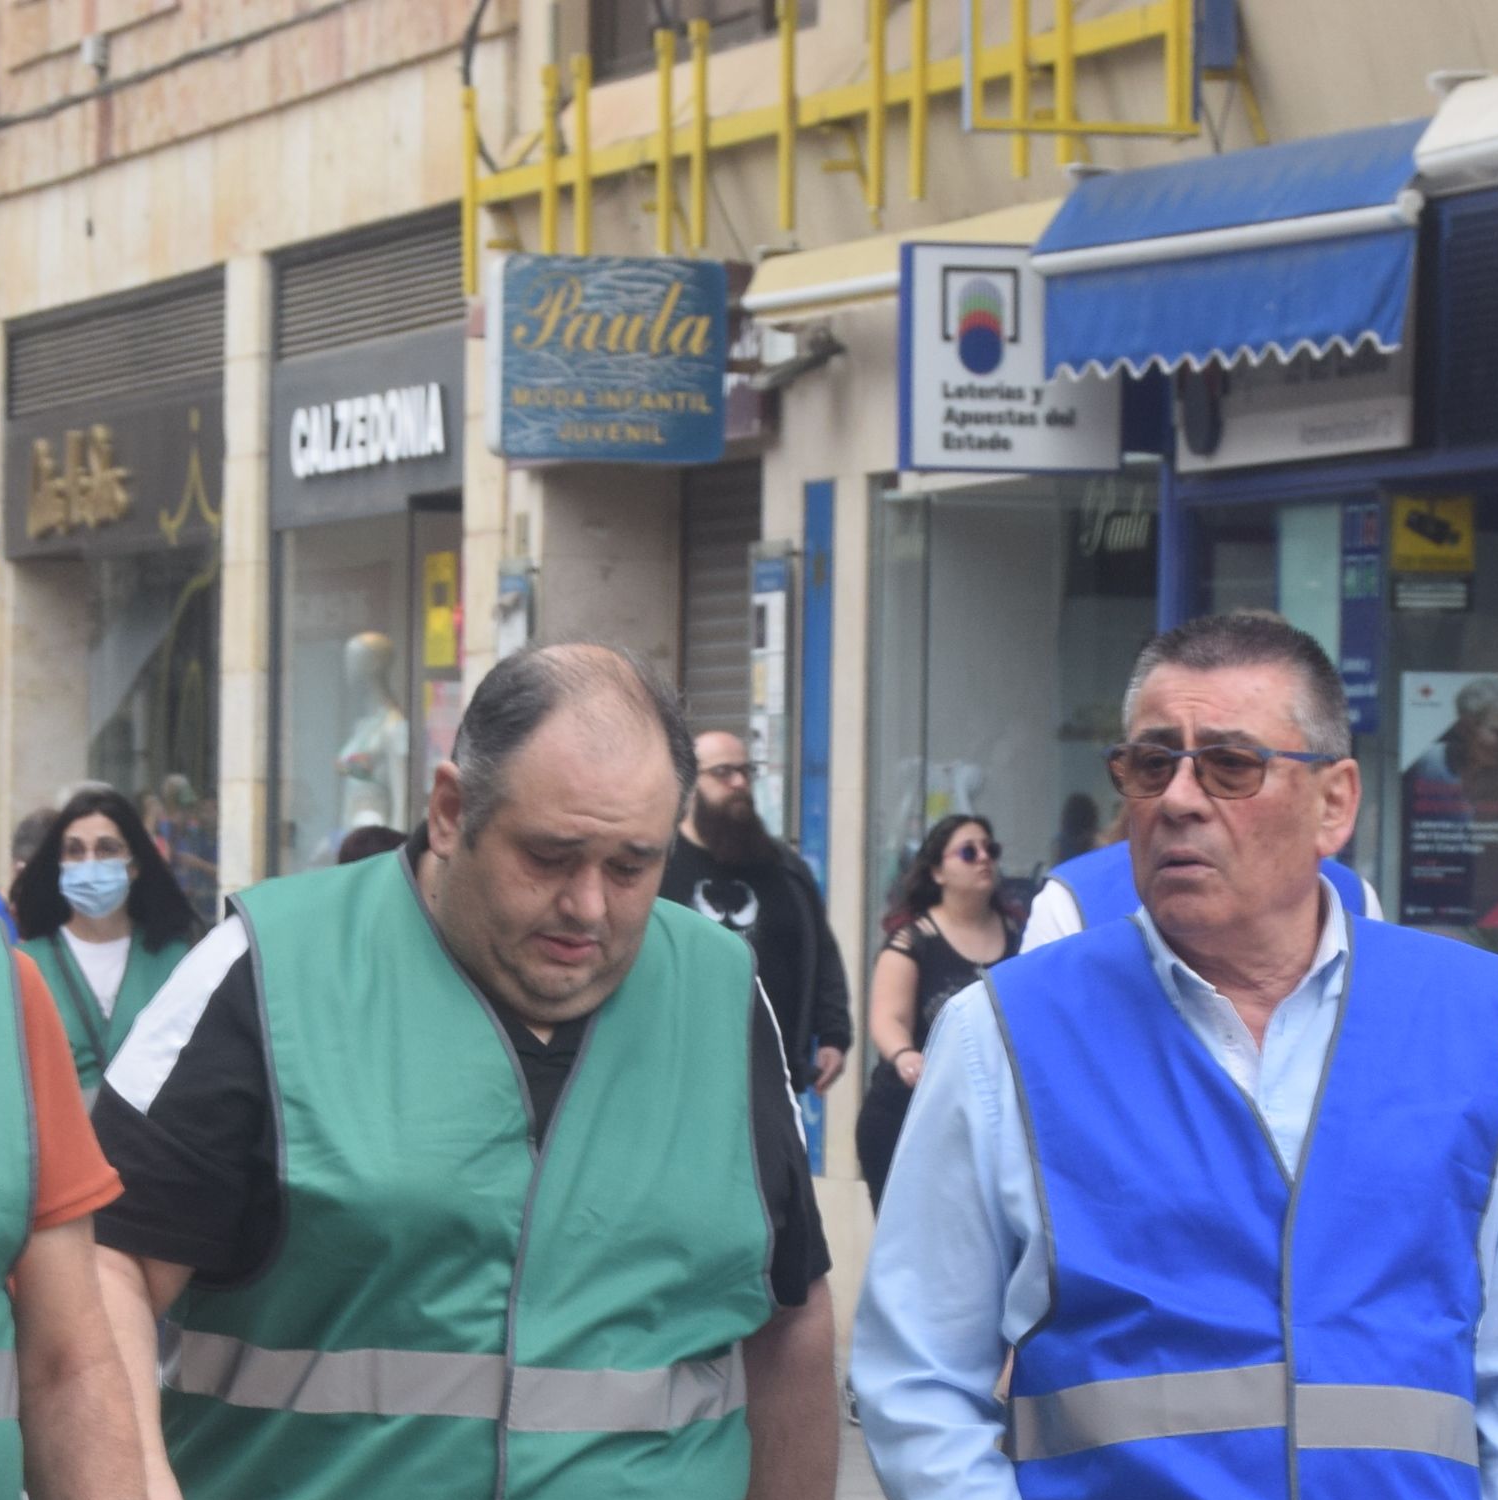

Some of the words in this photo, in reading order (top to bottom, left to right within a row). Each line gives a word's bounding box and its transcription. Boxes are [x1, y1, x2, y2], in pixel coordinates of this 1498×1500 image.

[512, 270, 712, 358] Paula
[511, 385, 587, 407] MODA
[597, 389, 713, 415] INFANTIL
[1032, 386, 1045, 406] y
[290, 381, 446, 478] CALZEDONIA
[944, 407, 1038, 429] Apuestas
[1045, 408, 1077, 428] del
[558, 422, 667, 446] JUVENIL
[941, 432, 1013, 451] Estado
